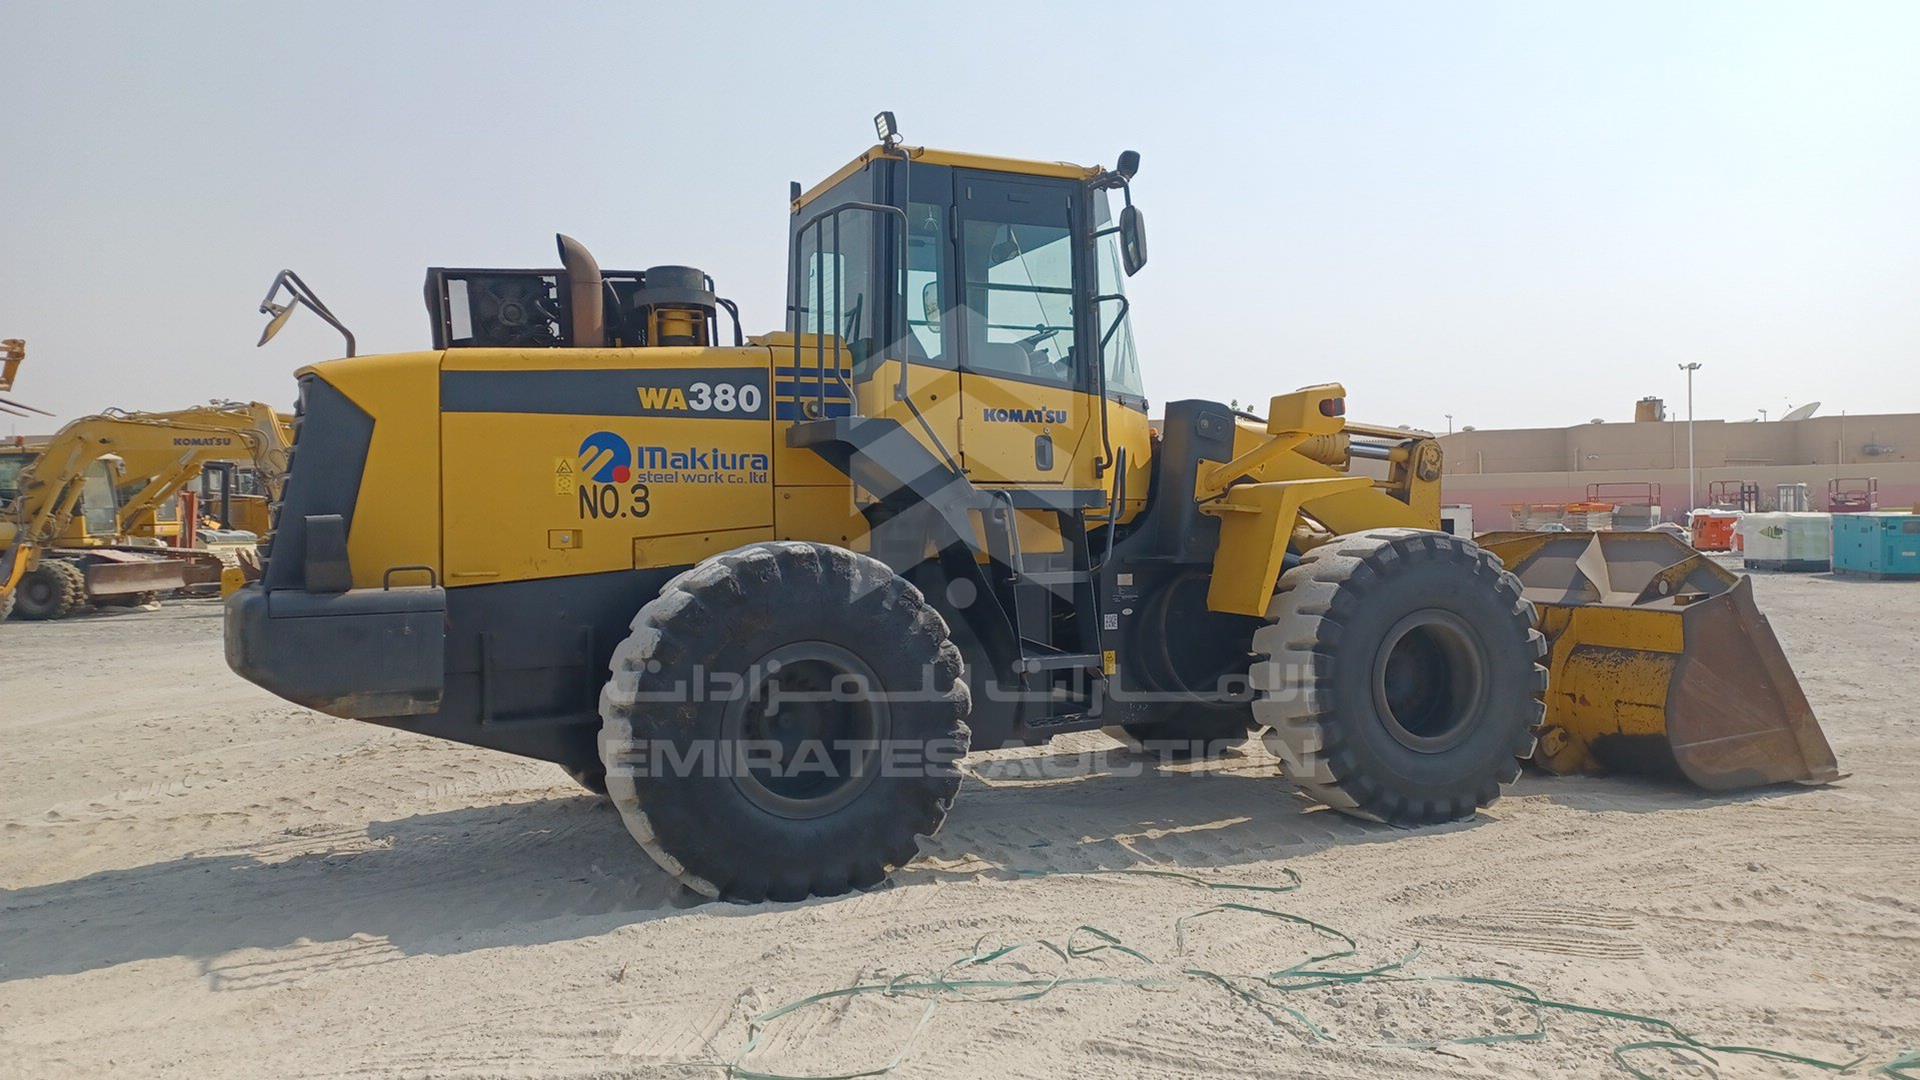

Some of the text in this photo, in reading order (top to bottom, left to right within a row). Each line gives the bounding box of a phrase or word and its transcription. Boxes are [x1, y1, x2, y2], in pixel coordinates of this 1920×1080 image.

[636, 382, 762, 413] WA380
[983, 405, 1067, 424] KOMATSU
[173, 437, 231, 446] KOMATSU
[637, 470, 678, 484] steel
[681, 471, 724, 484] work
[578, 483, 650, 519] NO.3
